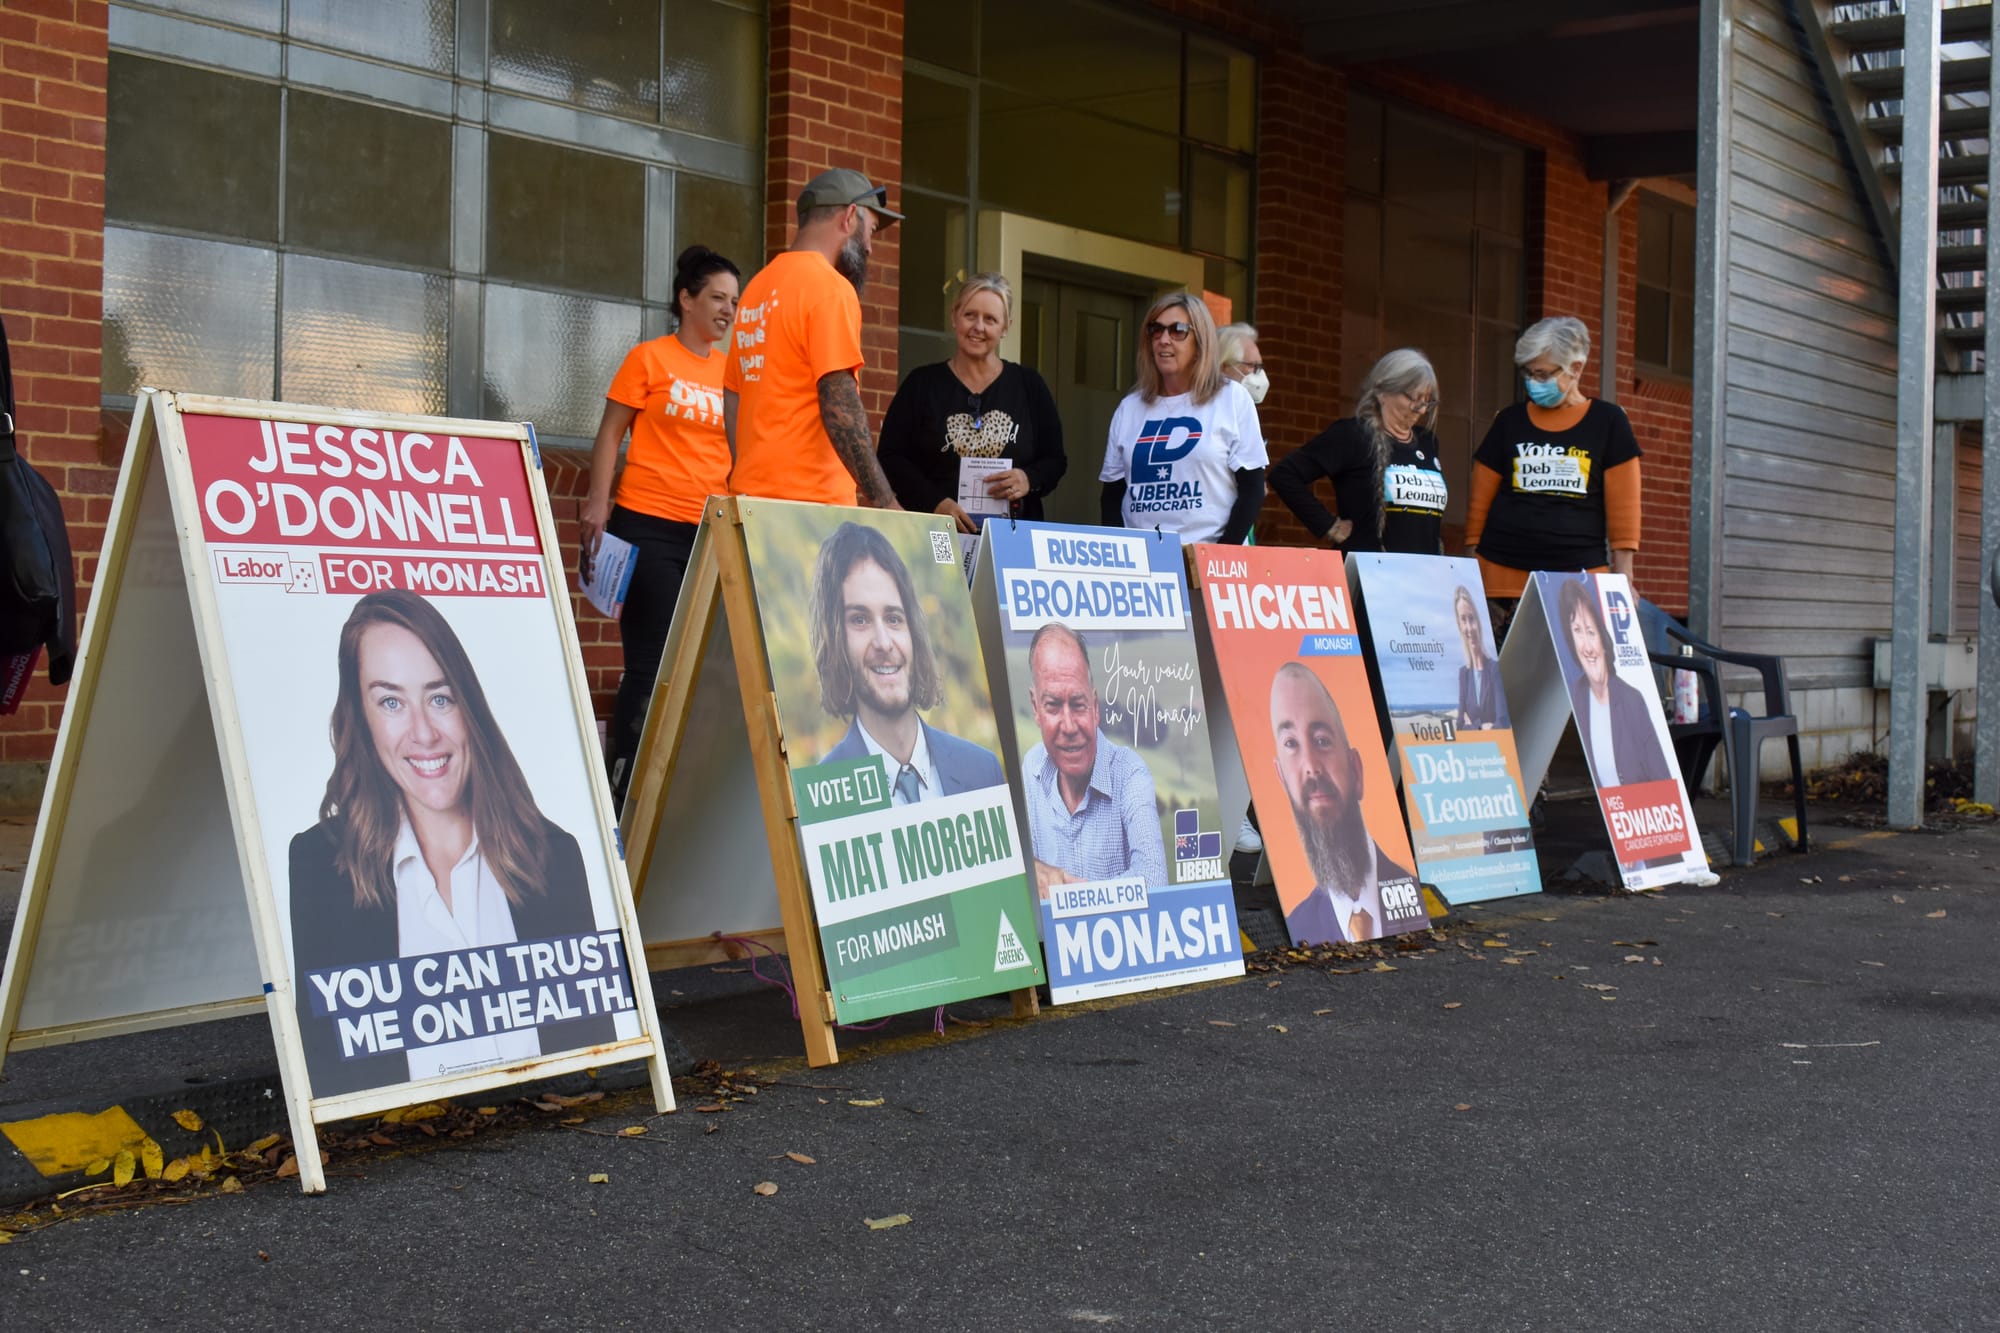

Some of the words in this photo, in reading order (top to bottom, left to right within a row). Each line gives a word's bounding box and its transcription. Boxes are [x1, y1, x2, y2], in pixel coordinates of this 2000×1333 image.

[248, 421, 483, 487] JESSICA
[1516, 442, 1565, 458] Vote
[1568, 446, 1589, 457] for
[1395, 474, 1422, 486] Deb
[1522, 463, 1551, 474] Deb
[1130, 481, 1202, 501] LIBERAL
[1522, 477, 1581, 488] Leonard
[1130, 498, 1202, 512] DEMOCRATS
[1397, 488, 1446, 504] Leonard
[205, 479, 536, 547] O'DONNELL
[1047, 538, 1137, 569] RUSSELL
[223, 556, 283, 578] Labor
[328, 559, 394, 590] FOR
[404, 562, 540, 593] MONASH
[1207, 560, 1248, 578] ALLAN
[1011, 579, 1175, 617] BROADBENT
[1208, 583, 1350, 631] HICKEN
[1403, 621, 1426, 636] Your
[1313, 637, 1353, 651] MONASH
[1389, 639, 1444, 657] Community
[1104, 642, 1150, 705] Your
[1155, 662, 1194, 684] voice
[1408, 656, 1435, 671] Voice
[1105, 707, 1122, 725] in
[1127, 685, 1201, 748] Monash
[1409, 722, 1442, 741] Vote
[1416, 749, 1465, 784] Deb
[807, 777, 853, 807] VOTE
[1424, 784, 1518, 824] Leonard
[1606, 796, 1624, 811] MEG
[1610, 804, 1683, 839] EDWARDS
[819, 832, 888, 903] MAT
[891, 805, 1012, 884] MORGAN
[1176, 859, 1224, 882] LIBERAL
[1056, 888, 1114, 910] LIBERAL
[1117, 884, 1144, 903] FOR
[1381, 883, 1418, 910] one
[1386, 905, 1422, 920] NATION
[836, 935, 872, 966] FOR
[872, 912, 946, 956] MONASH
[1001, 932, 1015, 948] THE
[1055, 903, 1232, 977] MONASH
[998, 947, 1024, 965] GREENS
[310, 963, 401, 1012] YOU
[413, 948, 500, 997] CAN
[506, 933, 621, 982] TRUST
[337, 1011, 405, 1058] ME
[412, 998, 475, 1044] ON
[484, 975, 634, 1032] HEALTH.
